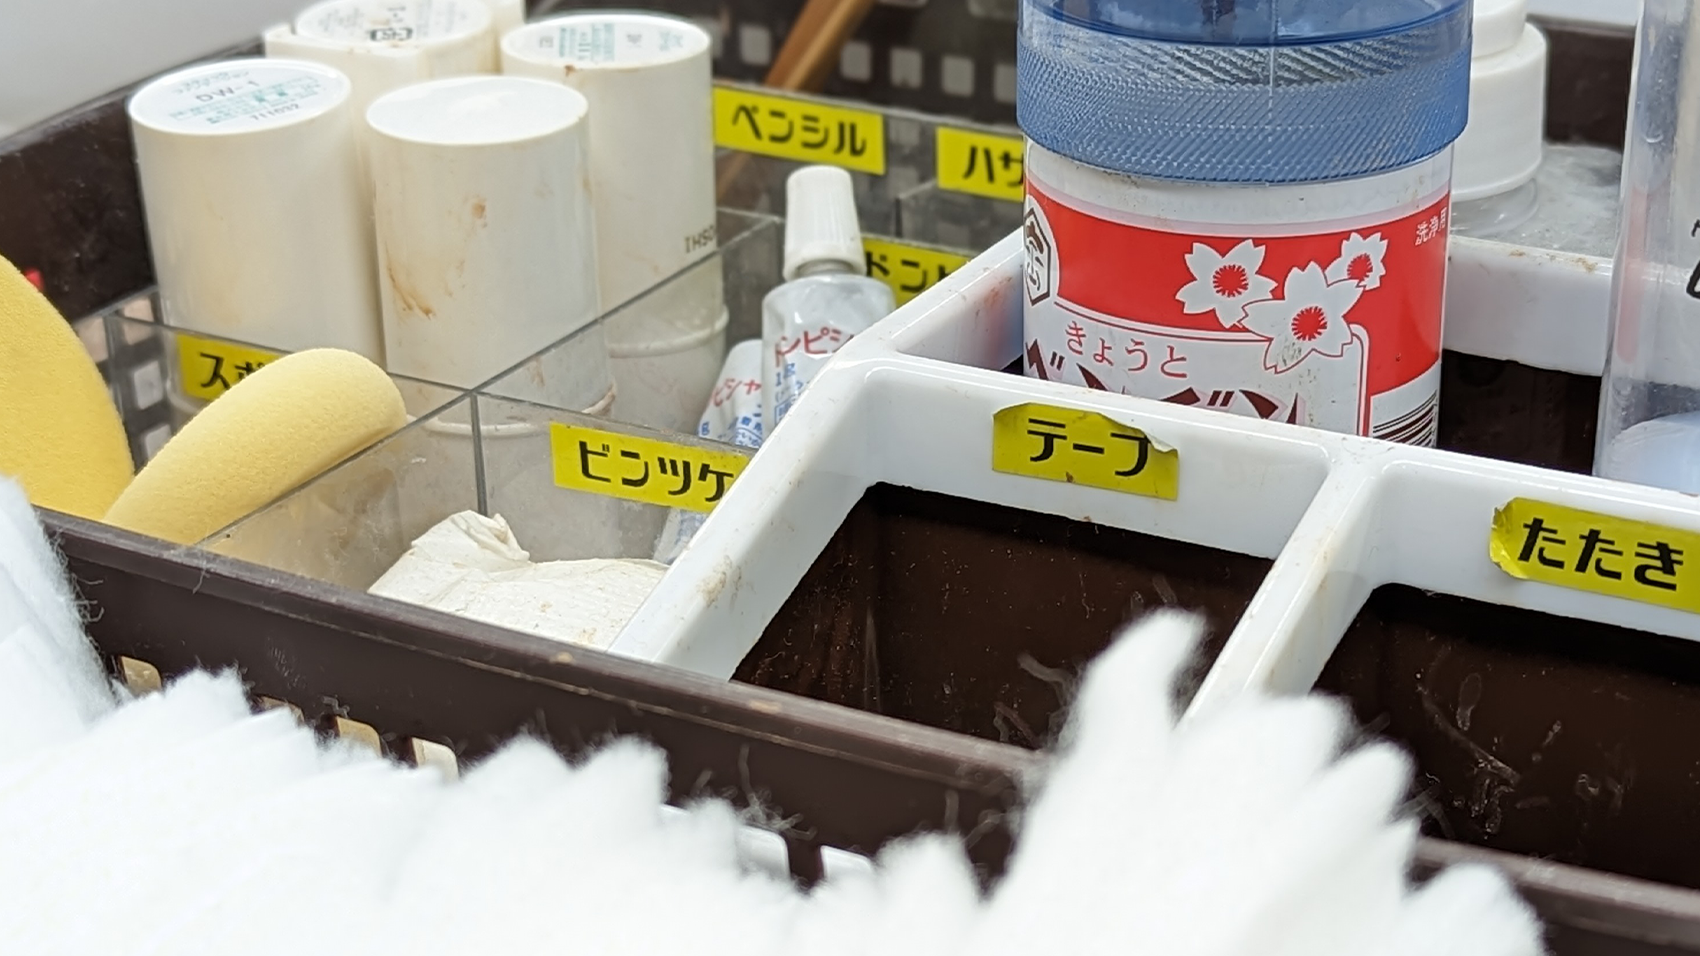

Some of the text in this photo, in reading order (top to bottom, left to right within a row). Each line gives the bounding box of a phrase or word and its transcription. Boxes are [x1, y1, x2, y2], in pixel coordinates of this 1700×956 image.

[731, 103, 867, 157] ペンシル
[1065, 320, 1188, 379] きょうと
[578, 440, 735, 503] ビンツケ
[1517, 516, 1685, 592] たたき
